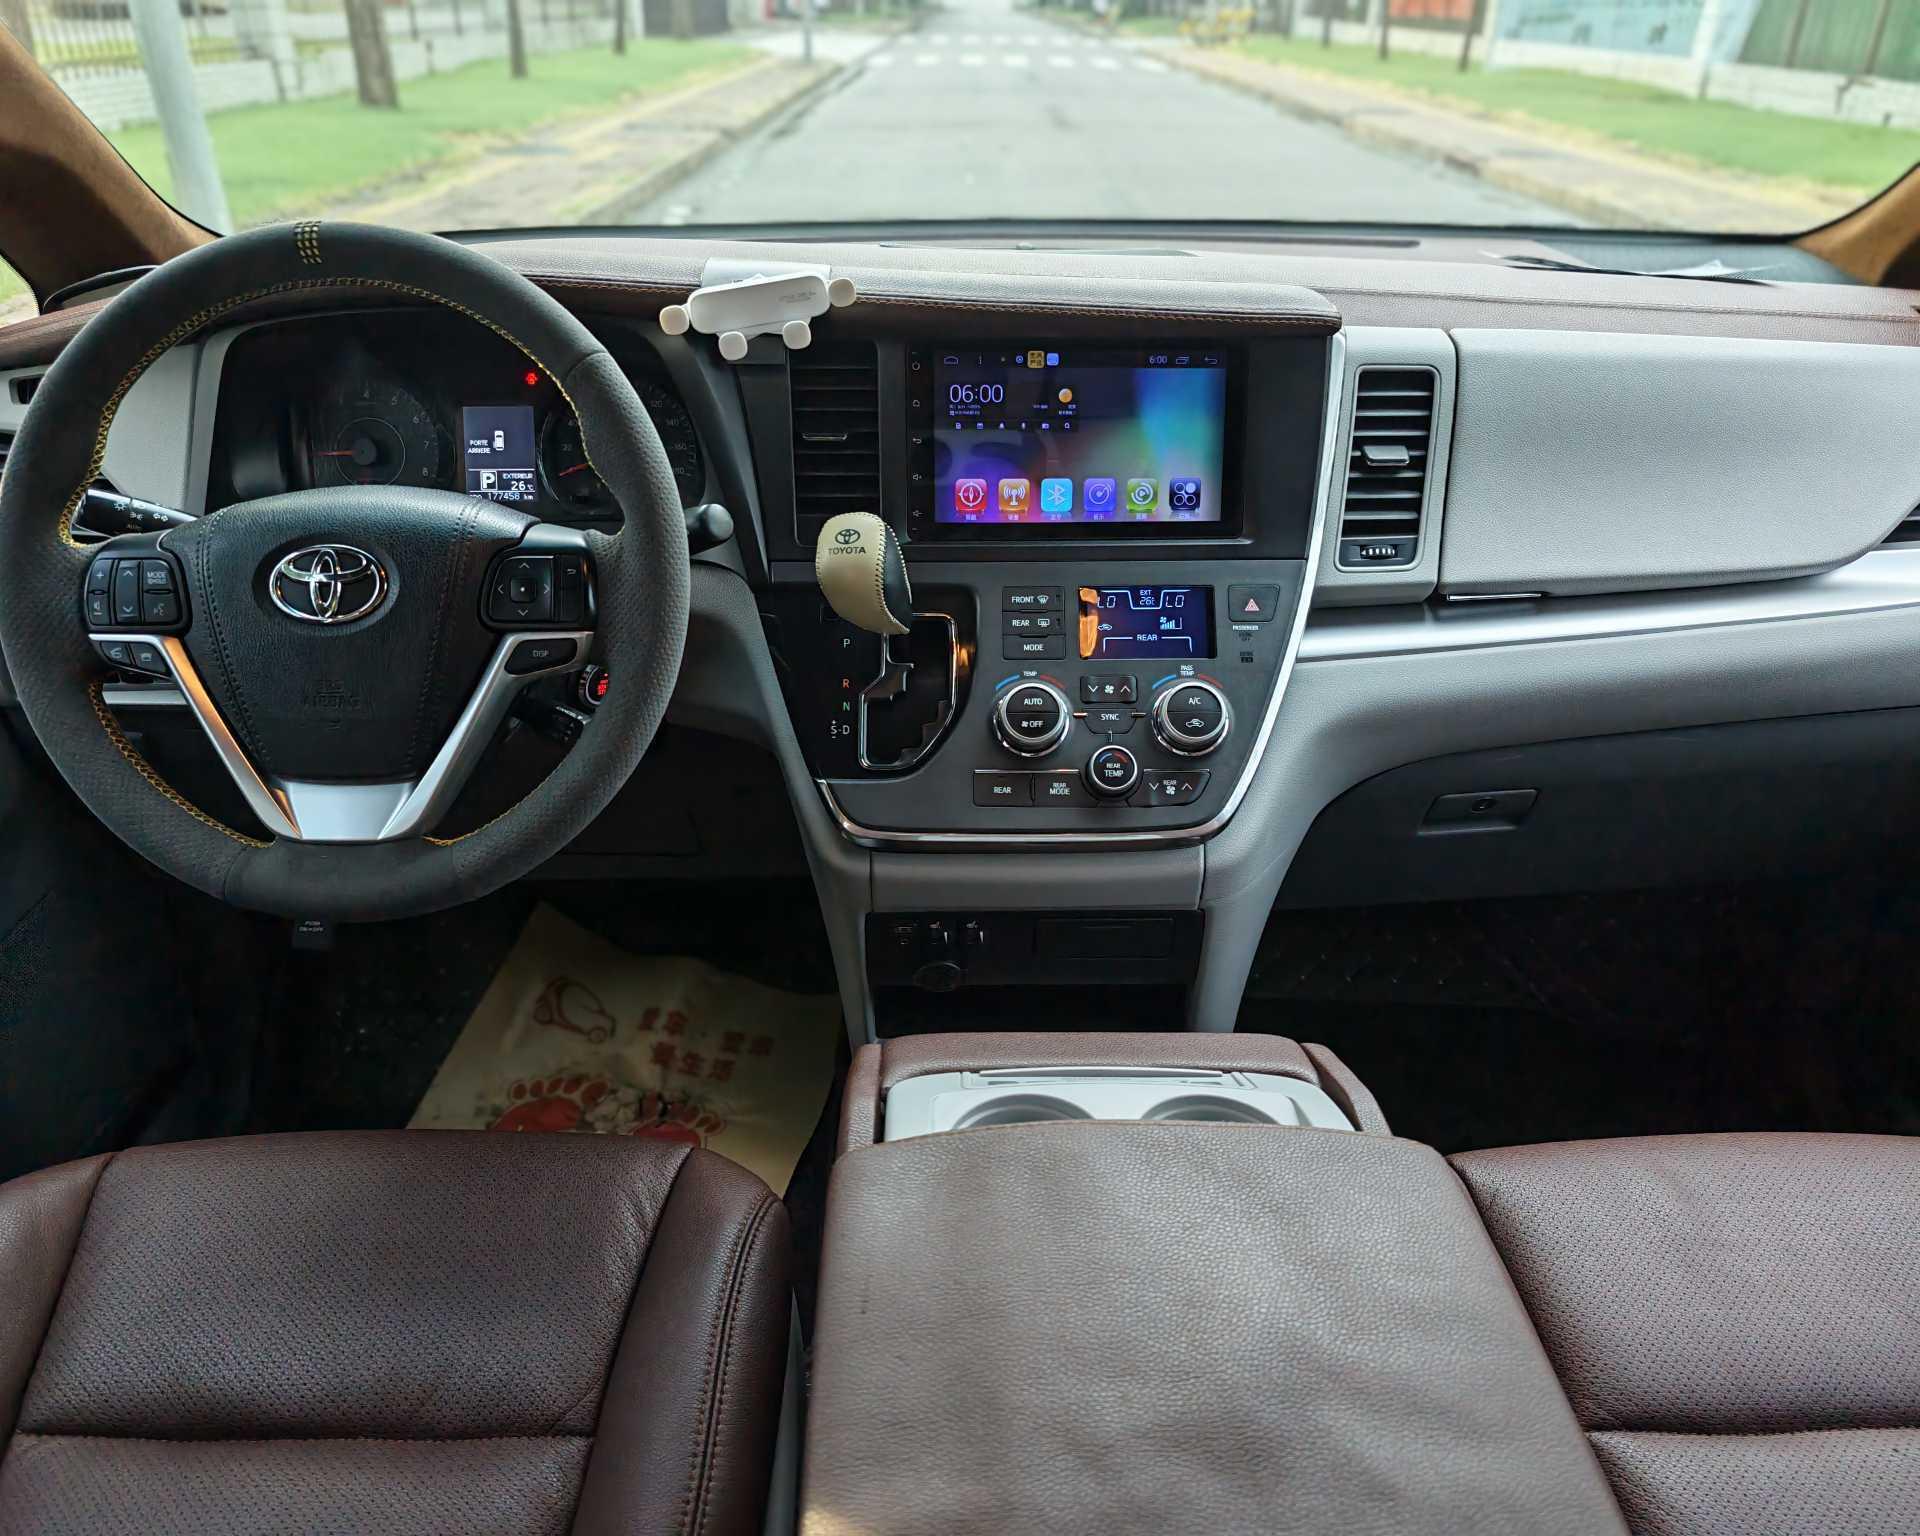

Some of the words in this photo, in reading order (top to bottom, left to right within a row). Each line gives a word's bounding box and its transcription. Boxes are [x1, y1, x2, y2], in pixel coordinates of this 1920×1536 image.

[1149, 355, 1168, 364] 6:00
[949, 384, 1004, 403] 06:00
[482, 472, 495, 489] P
[511, 480, 526, 491] 26
[828, 546, 866, 555] TOYOTA
[1011, 596, 1035, 604] FRONT
[1012, 619, 1030, 627] REAR
[843, 638, 851, 649] P
[842, 678, 850, 688] R
[1023, 698, 1043, 706] AUTO
[1188, 697, 1202, 705] A/C
[842, 702, 850, 711] N
[1100, 713, 1120, 721] SYNC
[1029, 720, 1044, 728] OFF
[1104, 769, 1124, 778] TEMP
[993, 786, 1012, 794] REAR
[1049, 787, 1071, 795] MODE
